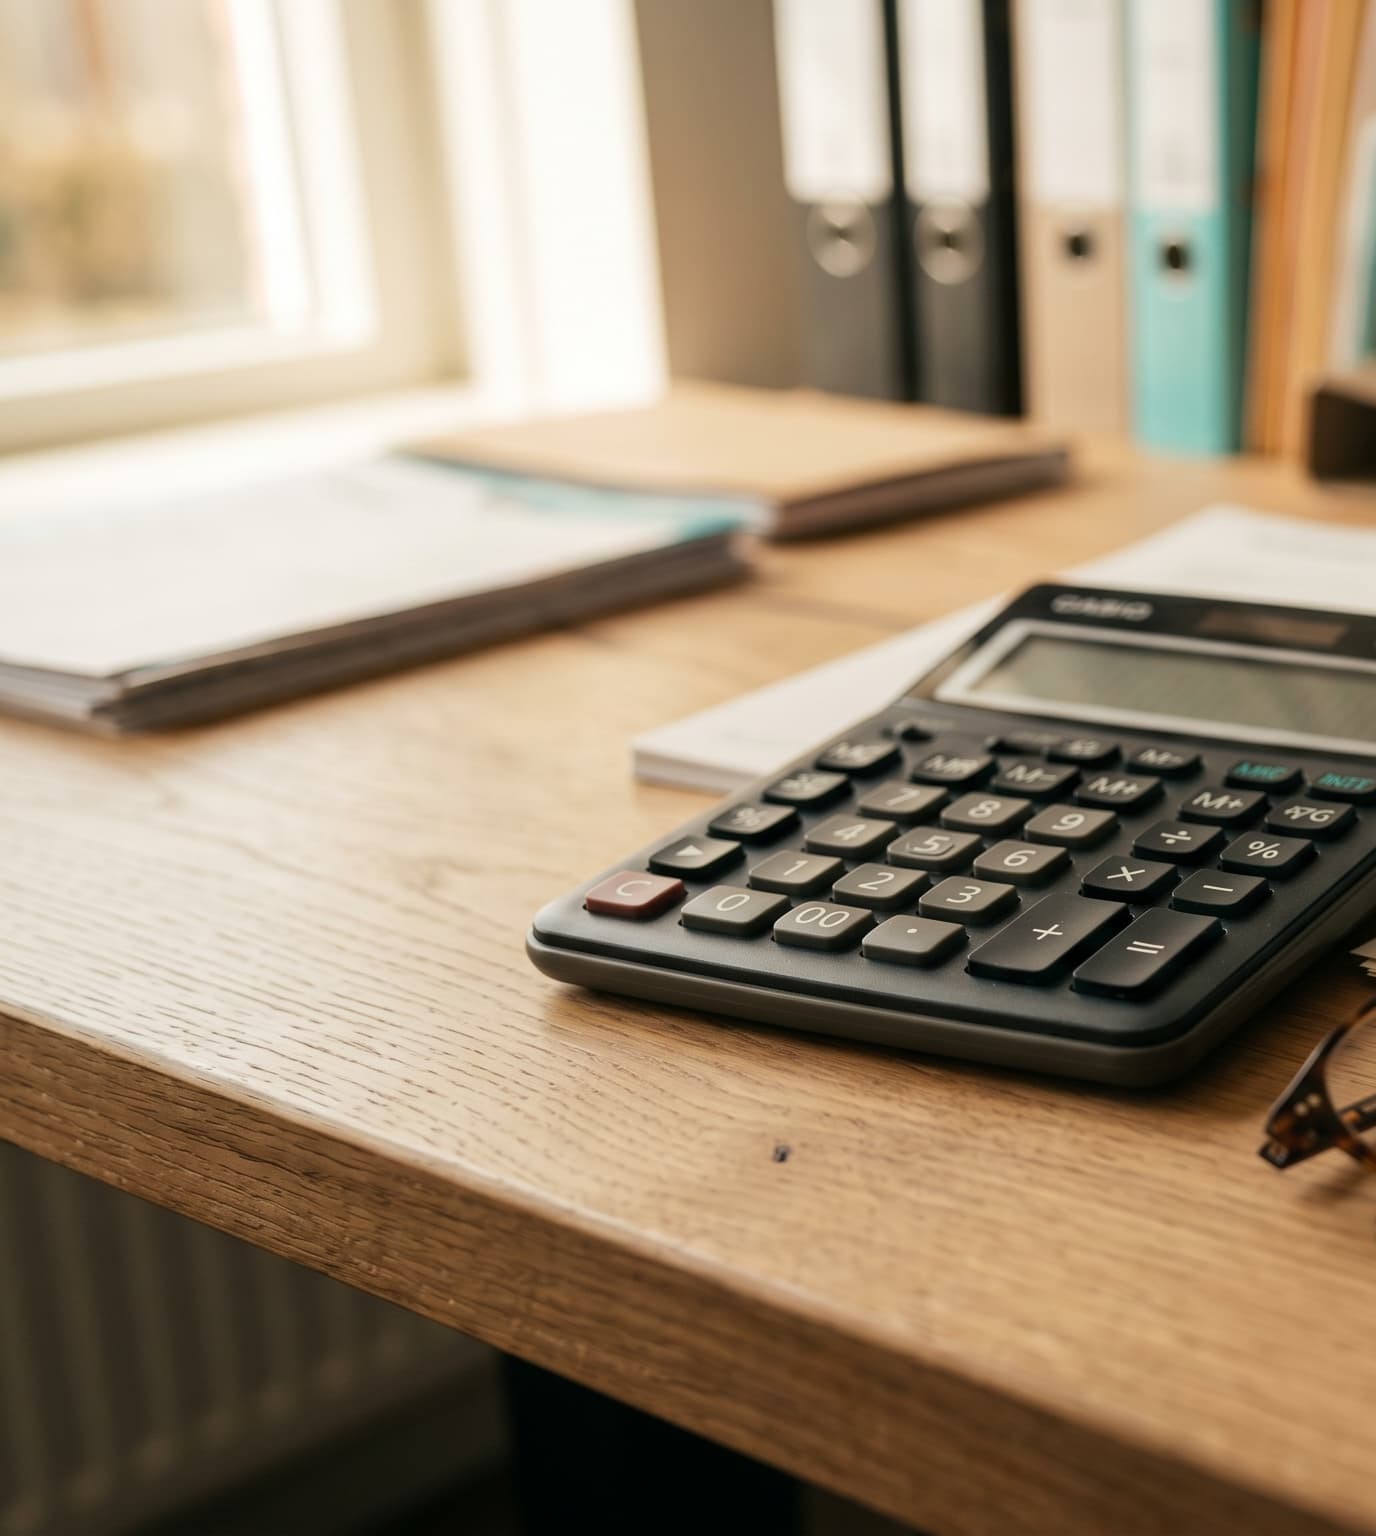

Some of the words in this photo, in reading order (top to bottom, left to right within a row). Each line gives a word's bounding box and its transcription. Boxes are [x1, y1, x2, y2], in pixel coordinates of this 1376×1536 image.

[886, 787, 920, 807] 7
[968, 800, 1001, 819] 8
[1051, 813, 1085, 831] 9
[834, 823, 867, 842] 4
[913, 835, 950, 854] 5
[1247, 840, 1281, 860] %
[783, 859, 809, 877] 1
[1003, 850, 1037, 867] 6
[615, 879, 653, 897] C
[857, 871, 896, 891] 2
[715, 893, 751, 913] 0
[945, 885, 982, 904] 3
[794, 906, 850, 928] 00
